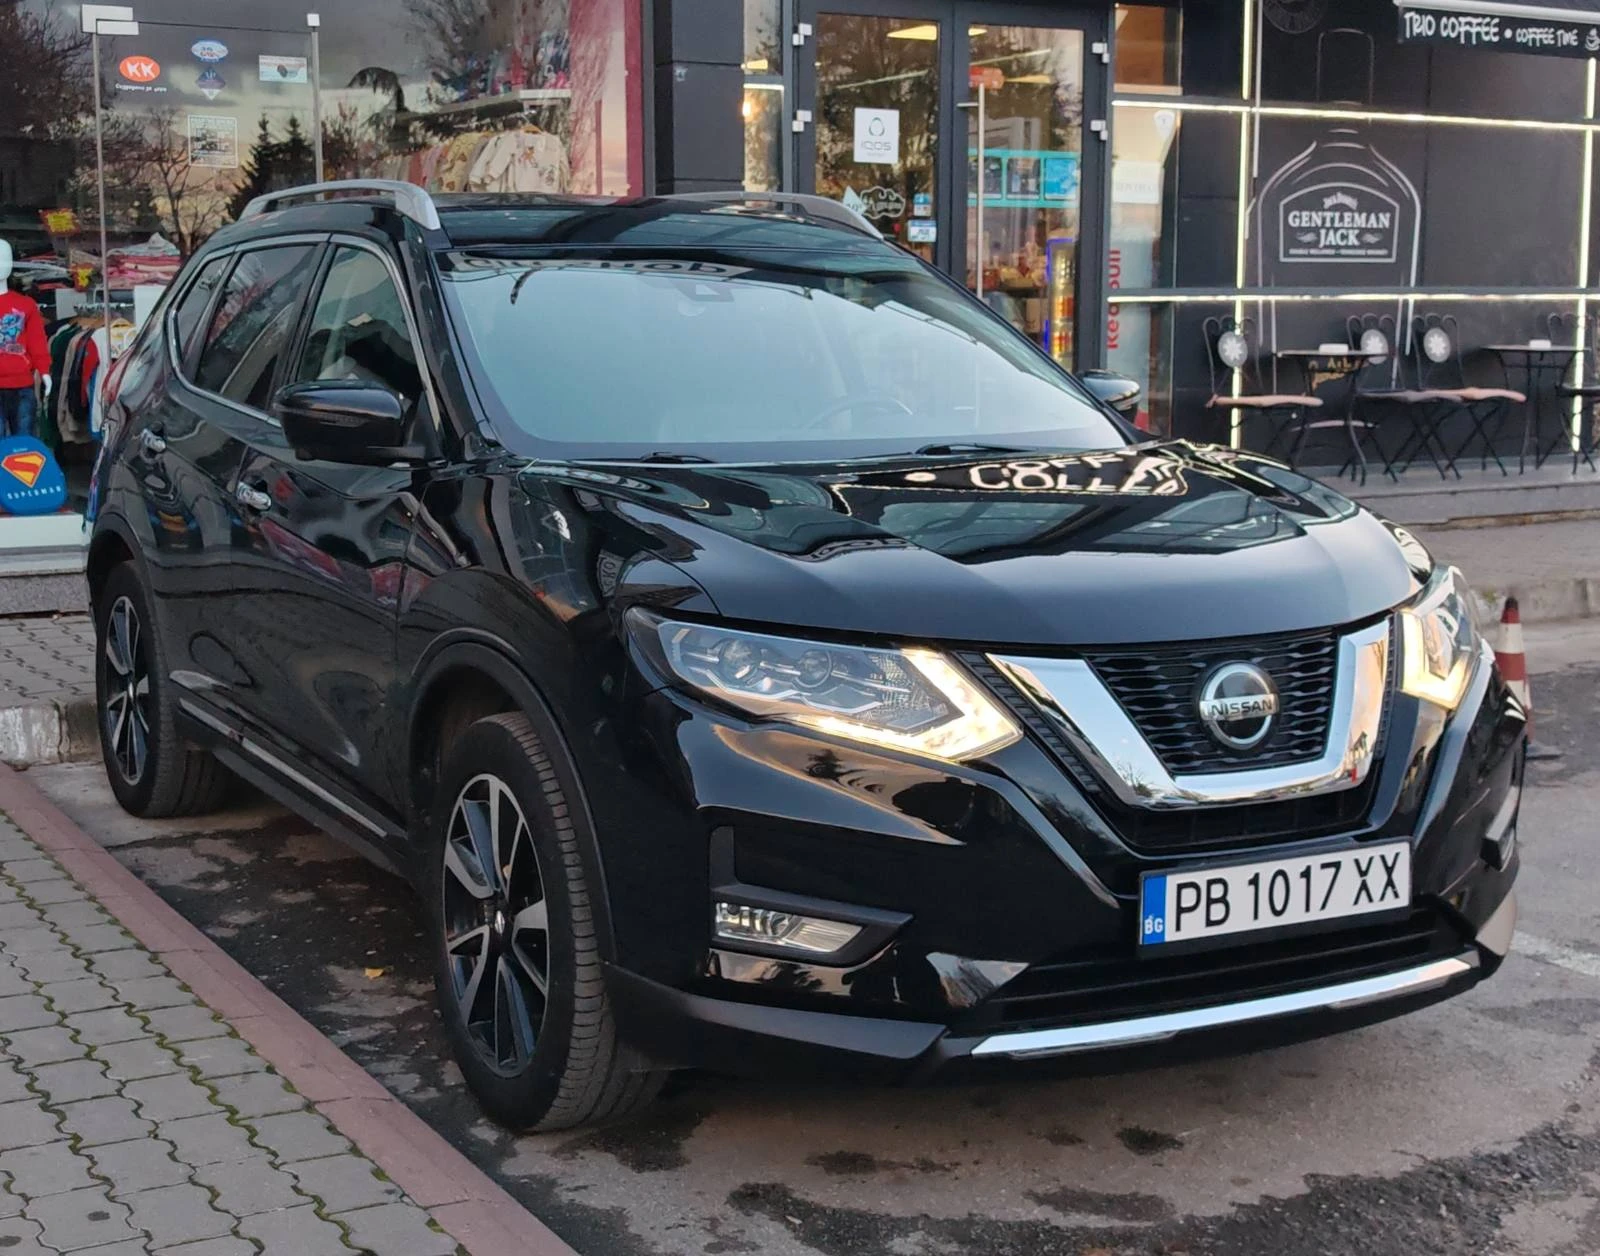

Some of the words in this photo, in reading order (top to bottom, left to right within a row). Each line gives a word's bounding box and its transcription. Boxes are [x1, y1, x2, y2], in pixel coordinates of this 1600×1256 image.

[1403, 12, 1436, 39] TRIO
[1439, 16, 1500, 45] COFFEE
[1515, 26, 1555, 48] COFFEE
[1555, 29, 1579, 48] TIME
[1288, 210, 1391, 229] GENTLEMAN
[1318, 228, 1360, 249] JACK
[1211, 699, 1273, 716] NISSAN
[1175, 877, 1232, 932] PB
[1247, 860, 1342, 921] 1017
[1352, 851, 1401, 906] XX
[1144, 917, 1164, 936] BG
